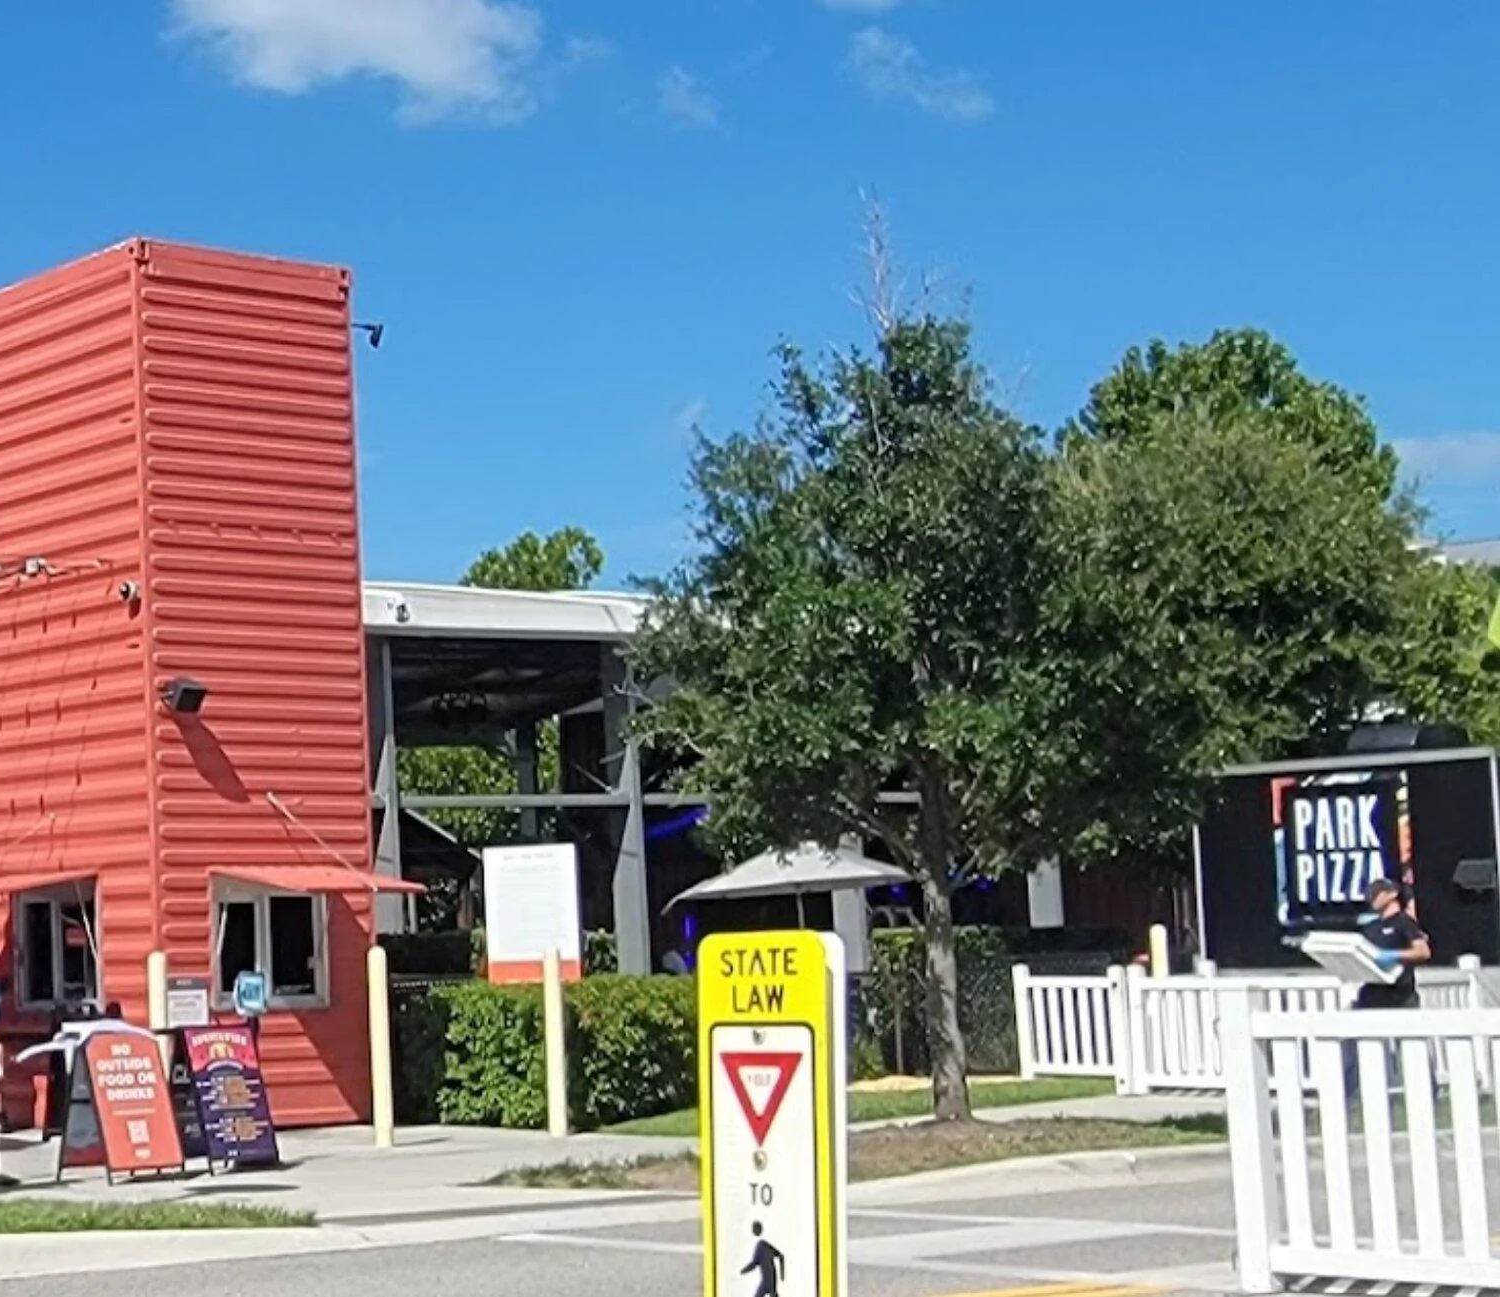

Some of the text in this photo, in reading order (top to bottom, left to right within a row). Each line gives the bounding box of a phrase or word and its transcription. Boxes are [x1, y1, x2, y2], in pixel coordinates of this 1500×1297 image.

[1293, 794, 1380, 850] PARK
[1296, 851, 1385, 902] PIZZA
[720, 948, 798, 977] STATE
[732, 984, 785, 1014] LAW
[110, 1044, 132, 1056] NO
[96, 1057, 153, 1072] OUTSIDE
[97, 1073, 136, 1088] FOOD
[749, 1183, 773, 1206] TO
